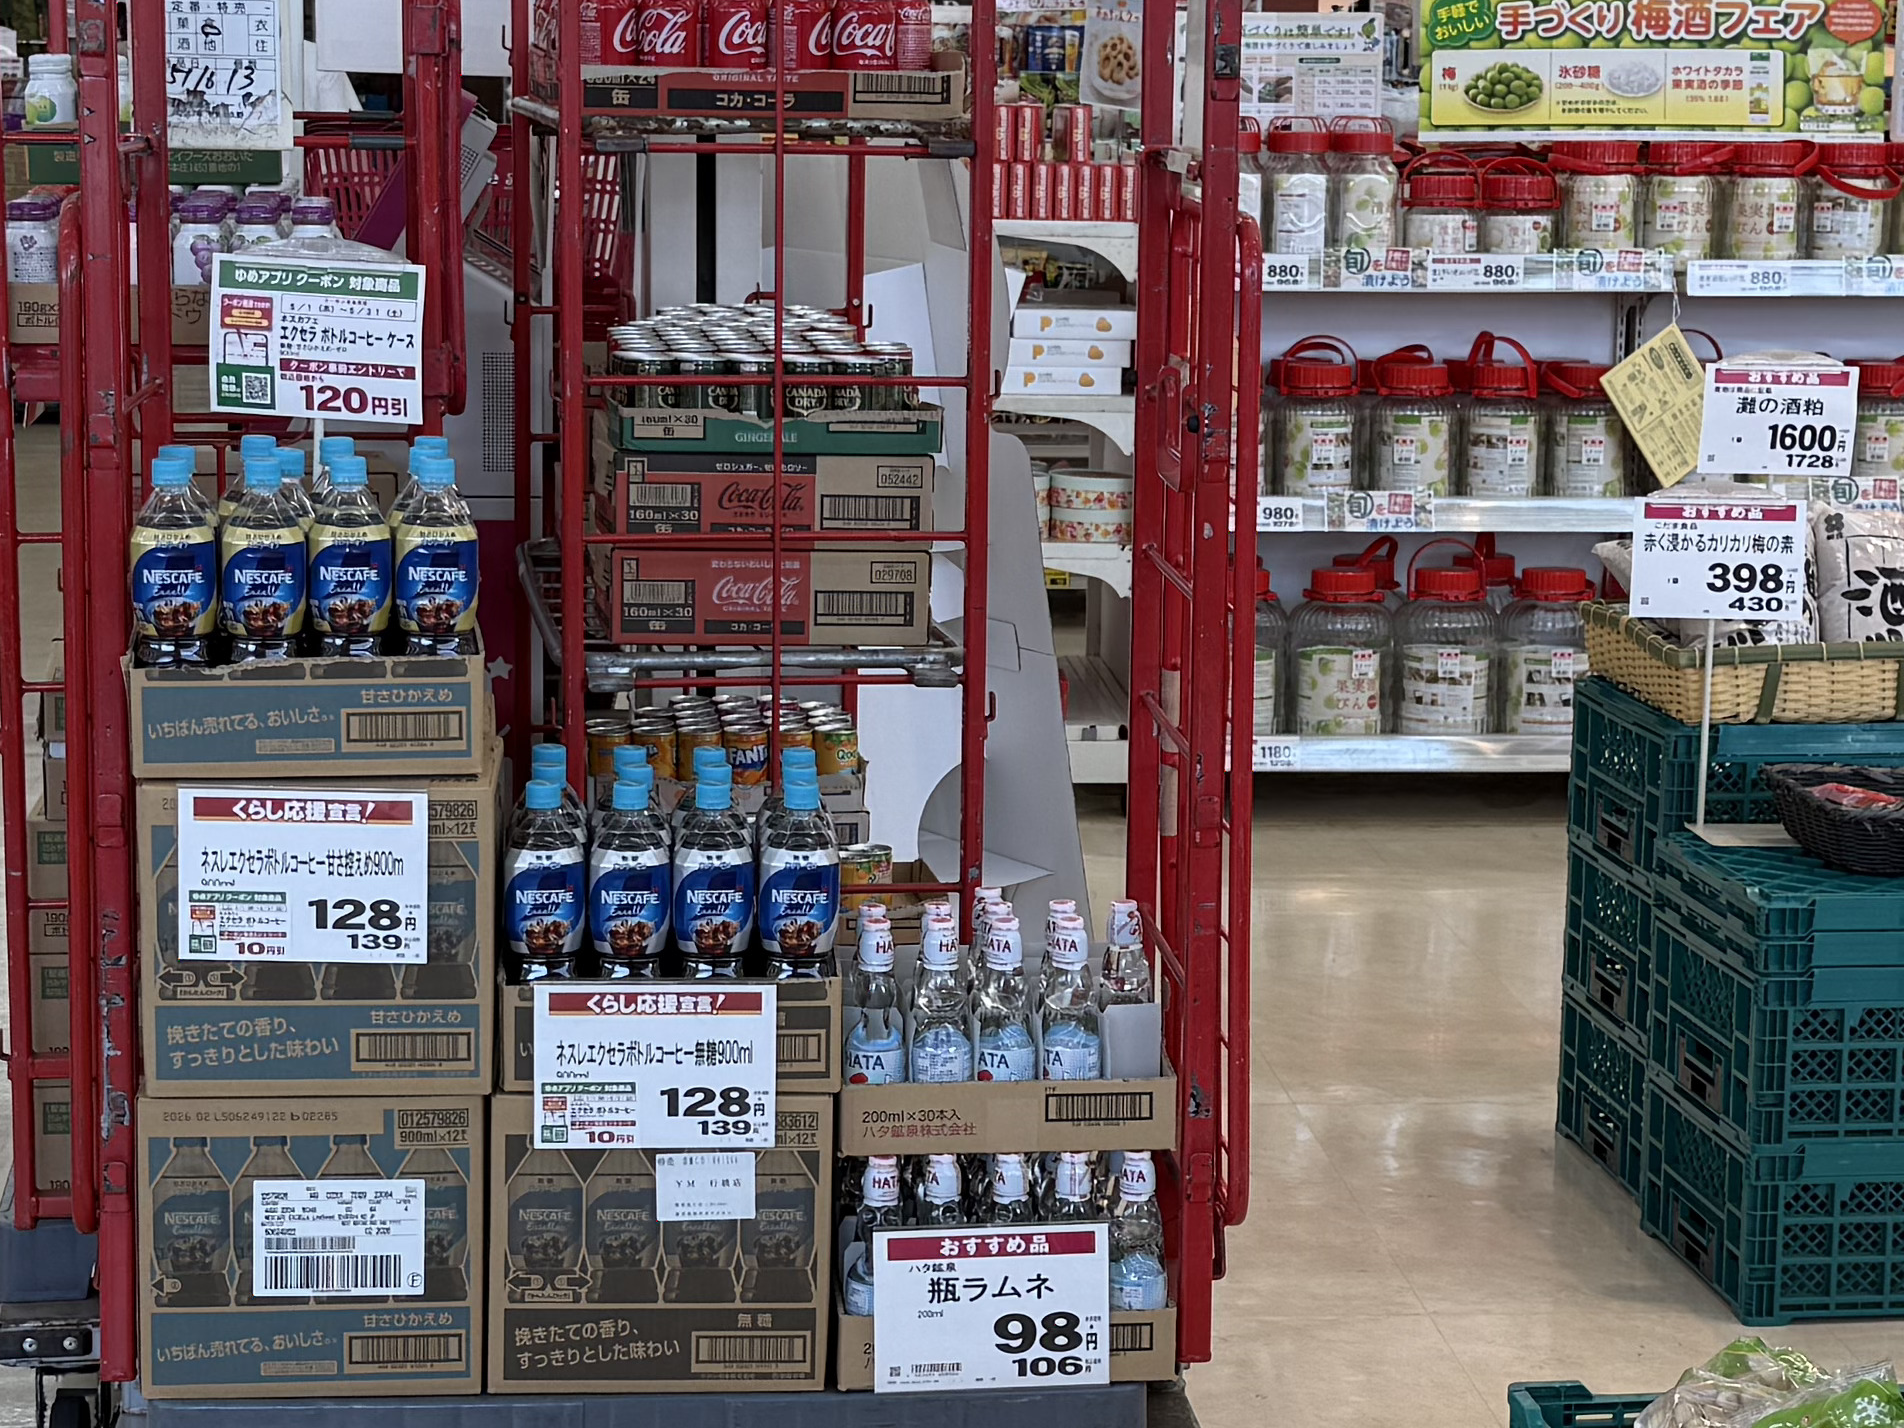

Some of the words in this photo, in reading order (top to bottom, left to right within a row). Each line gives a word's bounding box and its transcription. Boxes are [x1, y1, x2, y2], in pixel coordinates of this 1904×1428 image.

[1437, 0, 1479, 23] 手軽で
[1435, 14, 1492, 40] おいしい
[1558, 65, 1601, 79] 氷砂糖
[1671, 66, 1744, 77] ホワイトタカラ
[235, 269, 293, 284] ゆめアプリ
[296, 272, 345, 288] クーポン
[1266, 263, 1300, 280] 880
[280, 326, 317, 343] エクセラ
[321, 327, 384, 348] ボトルコーヒー
[387, 333, 415, 349] ケース
[1745, 370, 1821, 387] おすすめ品
[785, 386, 827, 398] CANADA
[1735, 396, 1825, 418] 灘の酒粕
[1767, 423, 1837, 452] 1600
[1785, 453, 1835, 468] 1728
[1681, 503, 1765, 521] おすすめ品
[1707, 563, 1784, 594] 398
[1728, 595, 1784, 612] 430
[360, 687, 453, 705] 甘さひかえめ
[231, 800, 376, 825] くらし応援宣言!
[307, 897, 403, 933] 128
[347, 933, 403, 951] 139
[585, 993, 726, 1017] くらし応援宣言!
[370, 1009, 461, 1025] 甘さひかえめ
[169, 1035, 339, 1070] すっきりとした味わい
[659, 1087, 752, 1117] 128
[398, 1111, 469, 1127] 012579826
[861, 1107, 962, 1125] 200ml×30本入
[696, 1119, 752, 1136] 139
[940, 1234, 1050, 1257] おすすめ品
[928, 1273, 1055, 1305] 瓶ラムネ
[362, 1312, 453, 1329] 甘さひかえめ
[993, 1311, 1084, 1355] 98
[1012, 1356, 1085, 1378] 106
